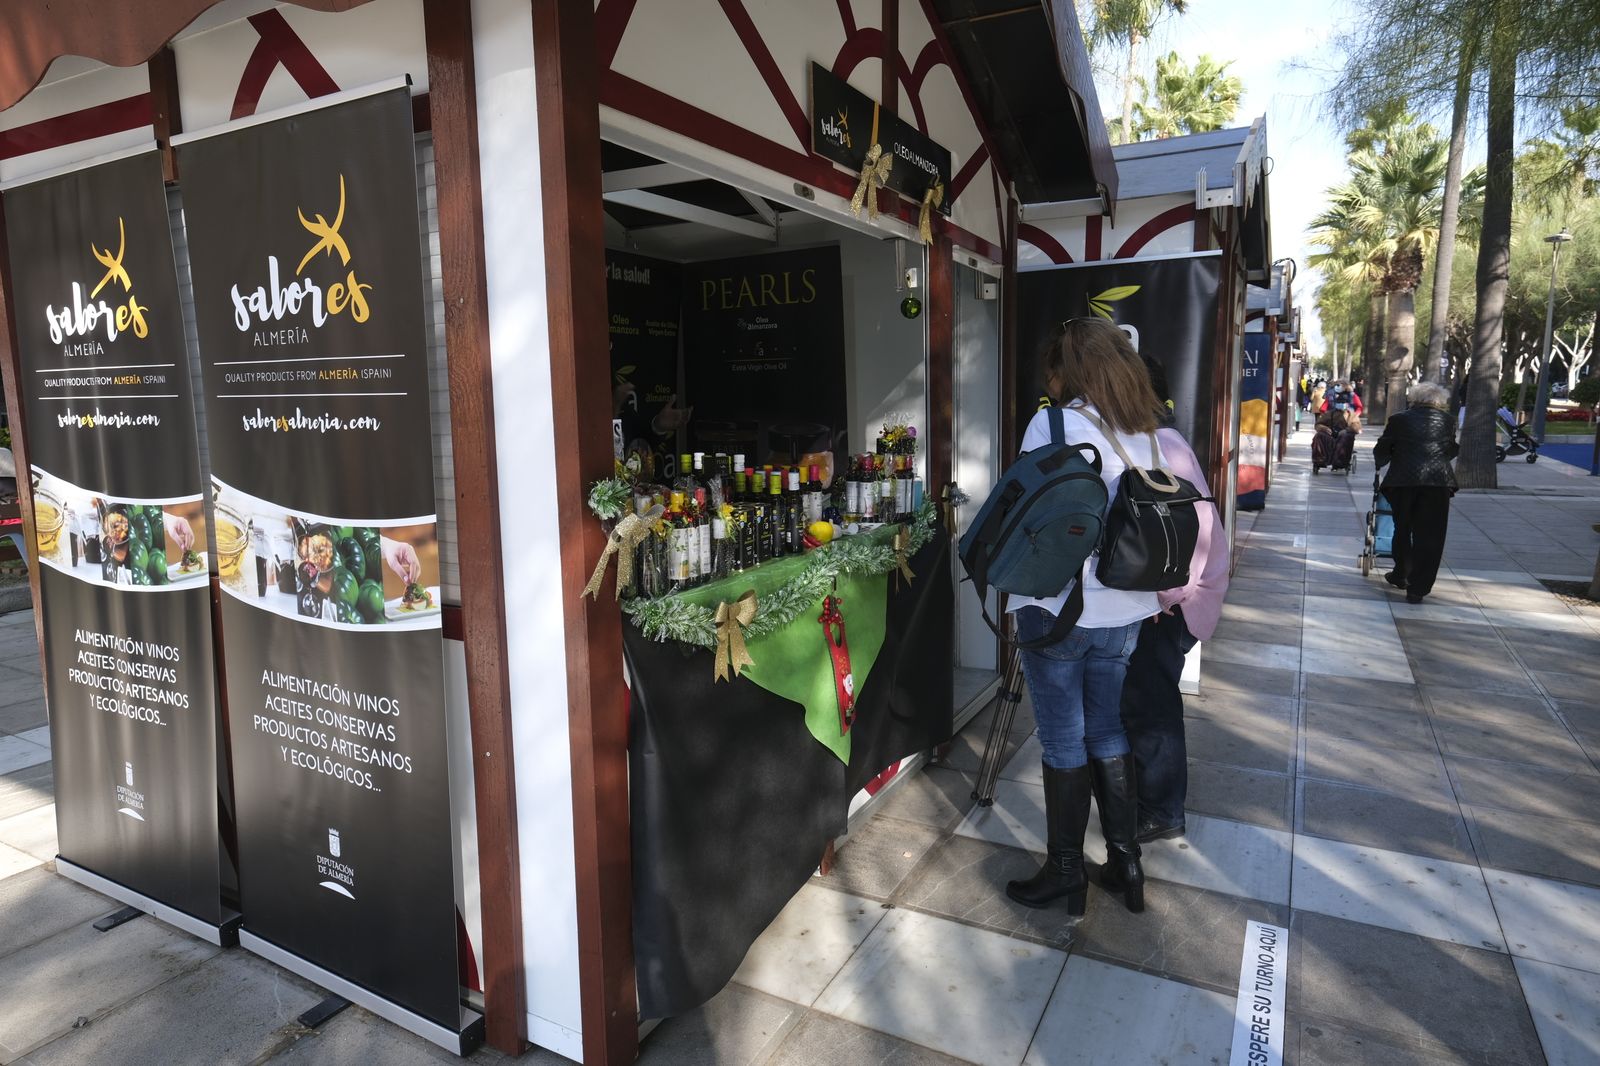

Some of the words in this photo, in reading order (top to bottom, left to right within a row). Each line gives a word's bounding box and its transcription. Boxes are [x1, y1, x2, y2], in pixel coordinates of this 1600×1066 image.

[893, 142, 939, 177] OLEOALMANZORA
[230, 255, 373, 332] sabores
[700, 268, 817, 311] PEARLS
[46, 281, 149, 345] sabores
[63, 340, 104, 357] ALMERÍA
[253, 326, 309, 346] ALMERÍA
[44, 378, 66, 388] QUALITY
[95, 376, 113, 386] FROM
[113, 374, 142, 386] ALMERÍA
[224, 372, 256, 383] QUALITY
[256, 370, 295, 382] PRODUCTS
[296, 370, 317, 381] FROM
[318, 367, 358, 380] ALMERÍA
[360, 368, 392, 379] (SPAIN)
[242, 406, 381, 433] saboresalmeria.com
[74, 628, 144, 656] ALIMENTACIÓN
[145, 641, 180, 662] VINOS
[77, 649, 116, 670] ACEITES
[116, 658, 177, 684] CONSERVAS
[68, 667, 125, 695] PRODUCTOS
[125, 681, 189, 709] ARTESANOS
[261, 669, 351, 707] ALIMENTACIÓN
[353, 691, 400, 717] VINOS
[89, 693, 95, 708] Y
[96, 694, 167, 726] ECOLÓGICOS...
[265, 693, 312, 721] ACEITES
[315, 707, 396, 742] CONSERVAS
[253, 714, 327, 749] PRODUCTOS
[330, 736, 413, 774] ARTESANOS
[280, 745, 287, 762] Y
[291, 749, 382, 792] ECOLÓGICOS...
[316, 854, 354, 877] DIPUTACIÓN
[318, 864, 328, 875] DE
[1257, 925, 1277, 954] AQUÍ
[1254, 953, 1275, 992] TURNO
[1253, 995, 1272, 1014] SU
